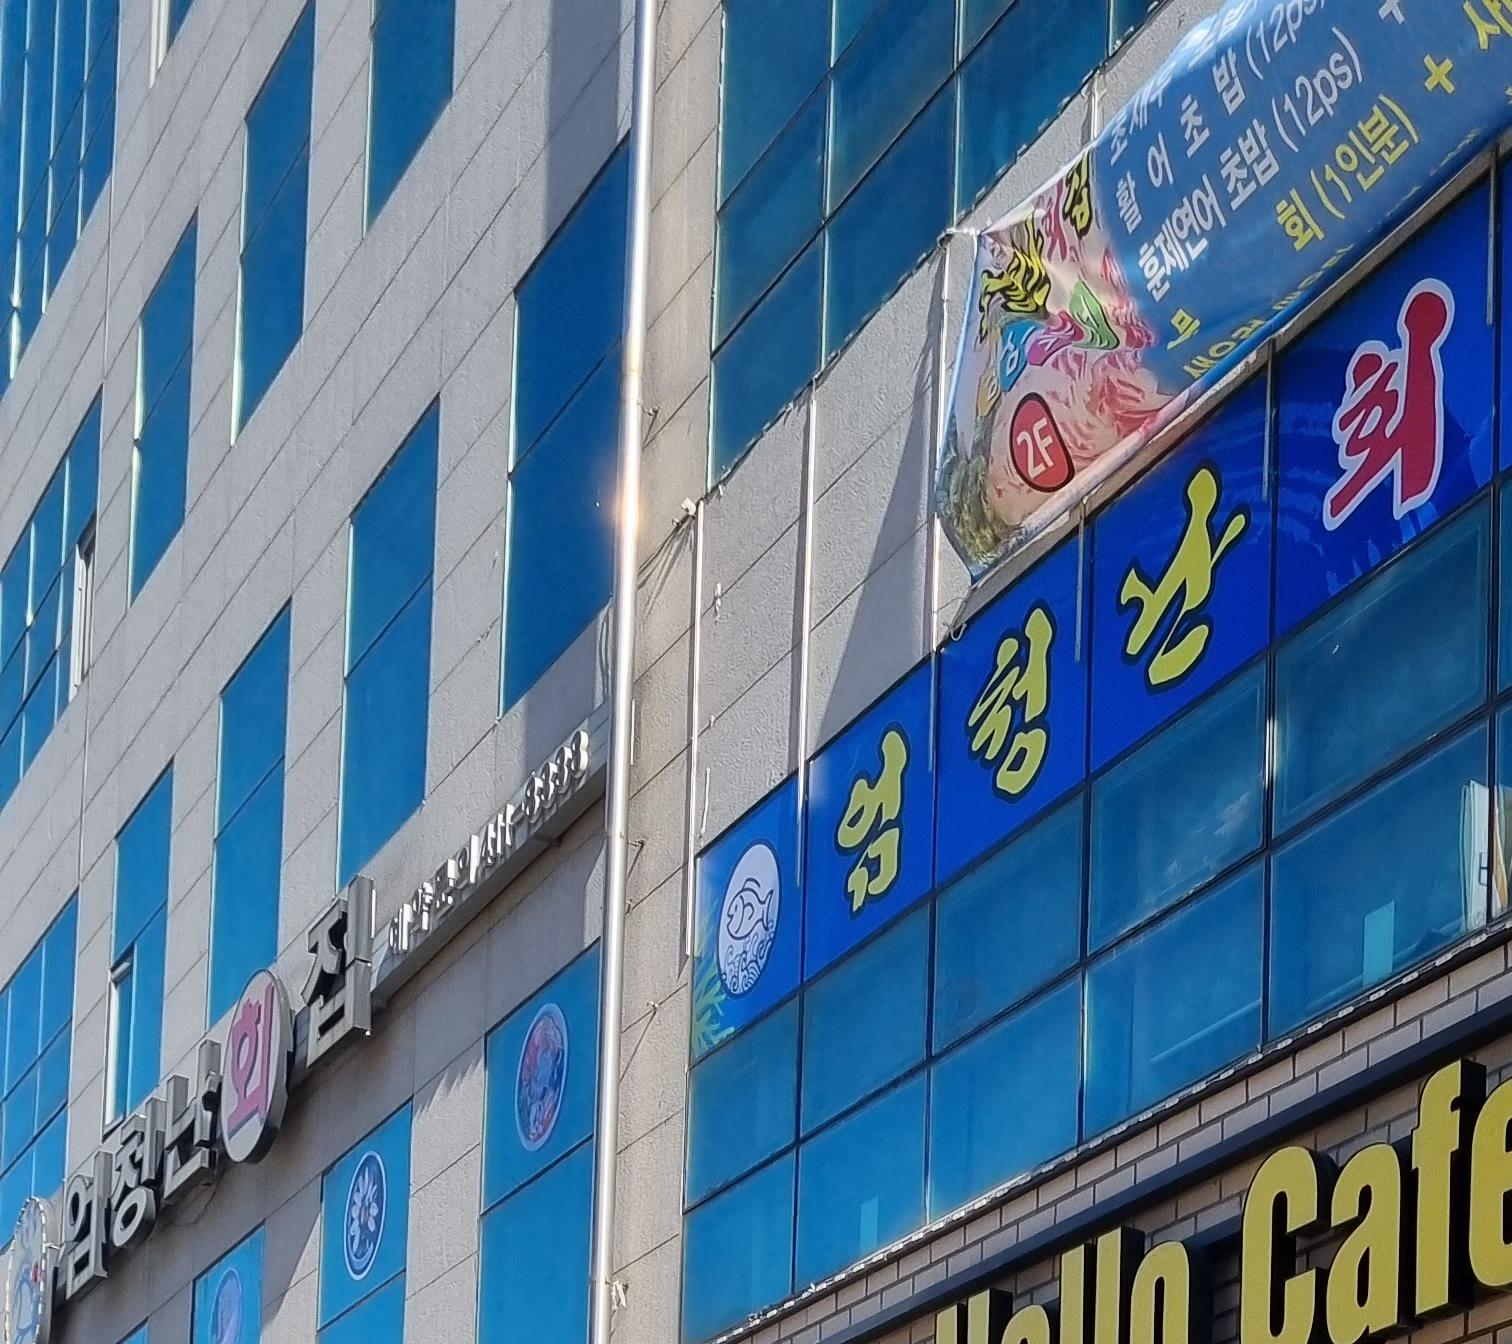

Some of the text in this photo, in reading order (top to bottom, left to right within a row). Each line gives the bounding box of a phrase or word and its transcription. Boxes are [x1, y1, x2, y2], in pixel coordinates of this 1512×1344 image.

[1246, 0, 1326, 80] (12p
[1138, 174, 1228, 304] 훈제연어
[1219, 118, 1280, 212] 초밥
[1272, 26, 1364, 154] (12ps)
[1275, 187, 1326, 252] 회
[1311, 93, 1419, 220] (1인분)
[1016, 415, 1056, 480] 2F
[65, 1040, 224, 1300] 엄청난
